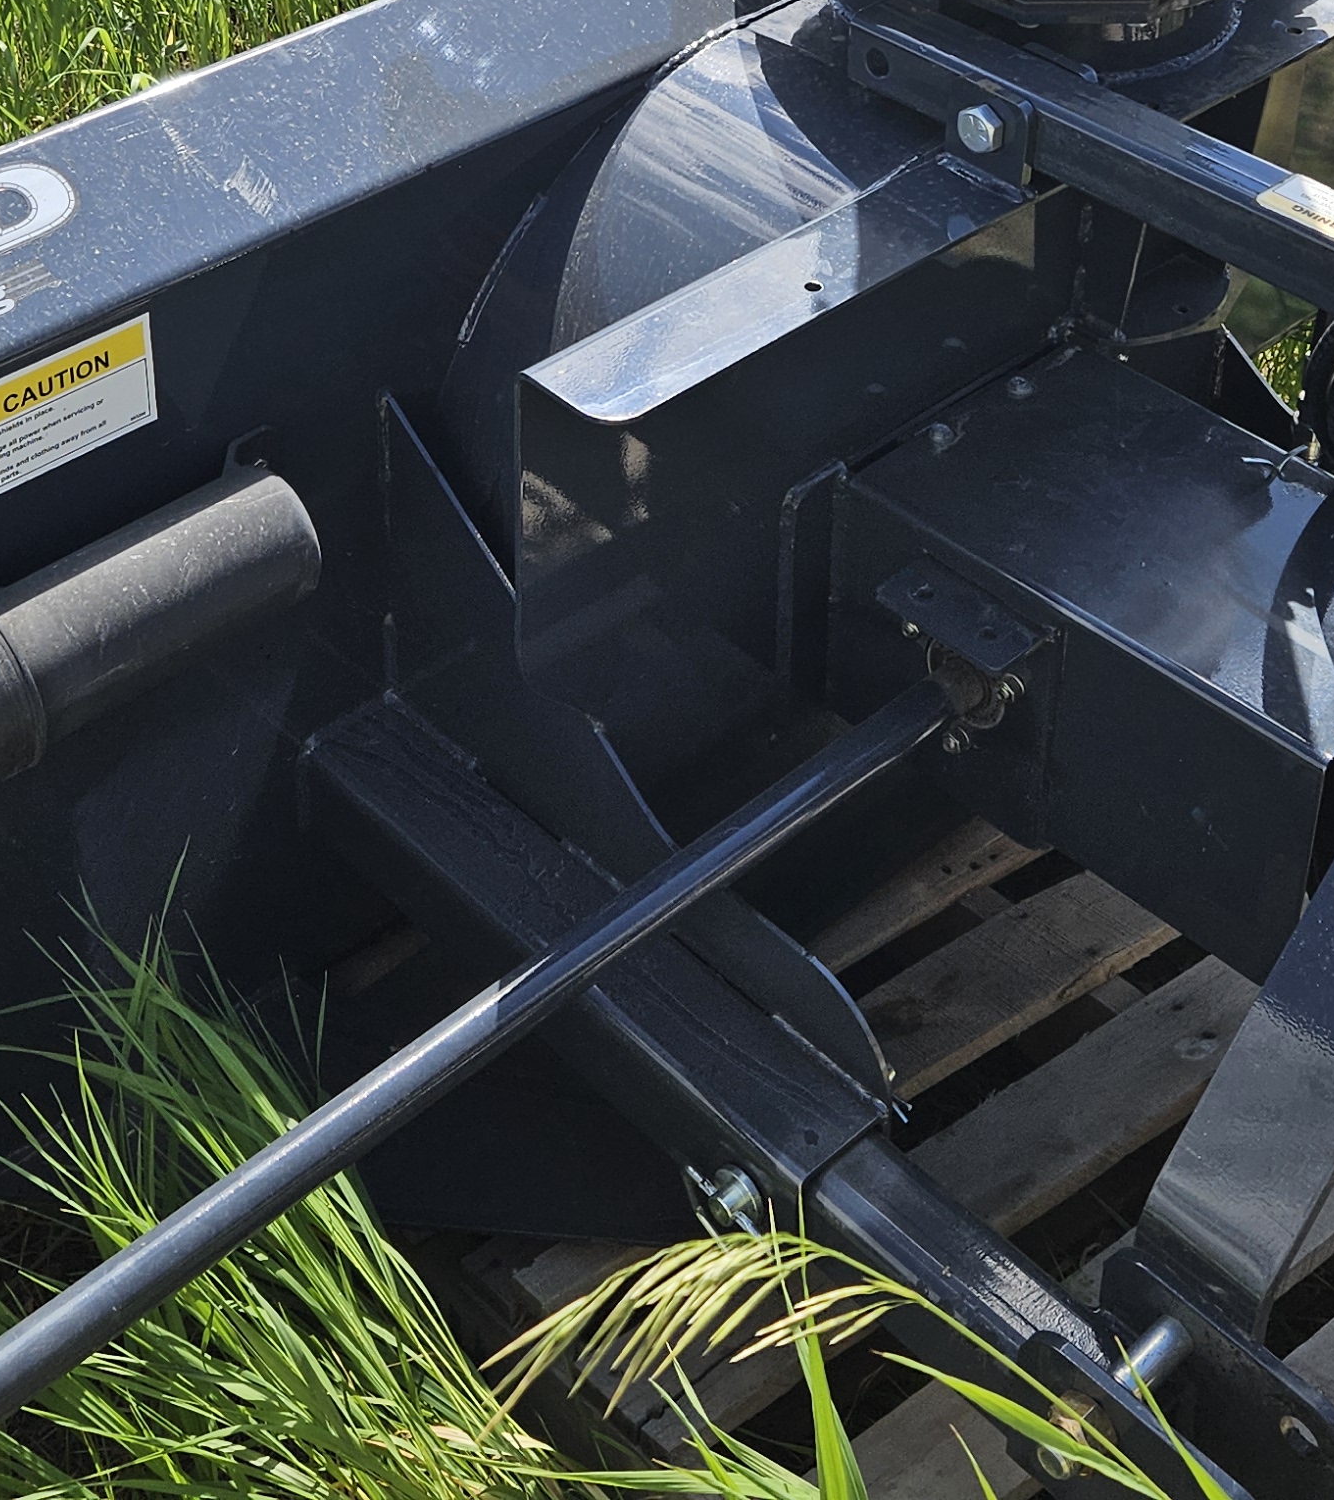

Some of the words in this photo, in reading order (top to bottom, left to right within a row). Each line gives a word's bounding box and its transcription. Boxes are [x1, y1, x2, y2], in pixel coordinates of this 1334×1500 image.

[3, 351, 110, 413] CAUTION
[9, 438, 17, 447] all
[19, 428, 41, 446] power
[42, 418, 61, 431] when
[63, 403, 95, 422] servicing
[25, 416, 33, 425] in
[34, 406, 54, 424] place.
[12, 435, 44, 453] machine.
[16, 457, 29, 469] and
[31, 442, 59, 461] clothing
[61, 433, 79, 450] away
[80, 425, 97, 437] from
[98, 420, 106, 429] all
[1, 470, 21, 485] parts.
